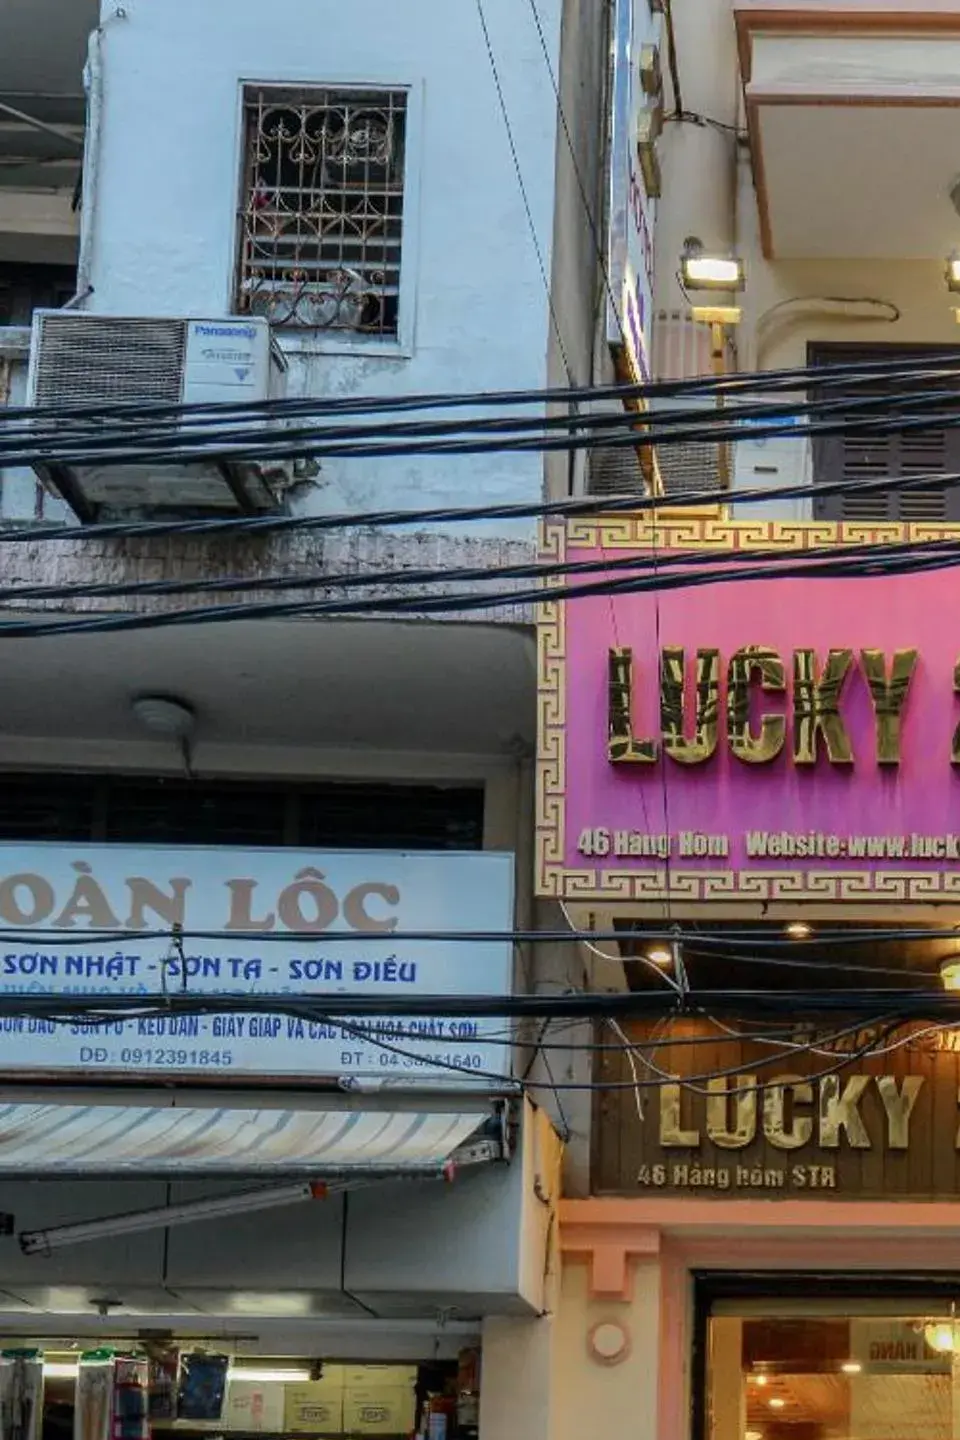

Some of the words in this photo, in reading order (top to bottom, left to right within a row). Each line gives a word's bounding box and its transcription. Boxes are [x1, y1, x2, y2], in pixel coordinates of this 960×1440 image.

[607, 646, 918, 767] LUCKY
[577, 828, 610, 857] 46
[4, 952, 55, 976] SƠN
[289, 957, 343, 982] SƠN
[121, 1048, 232, 1066] 0912391845
[659, 1073, 926, 1149] LUCKY
[637, 1165, 665, 1187] 46
